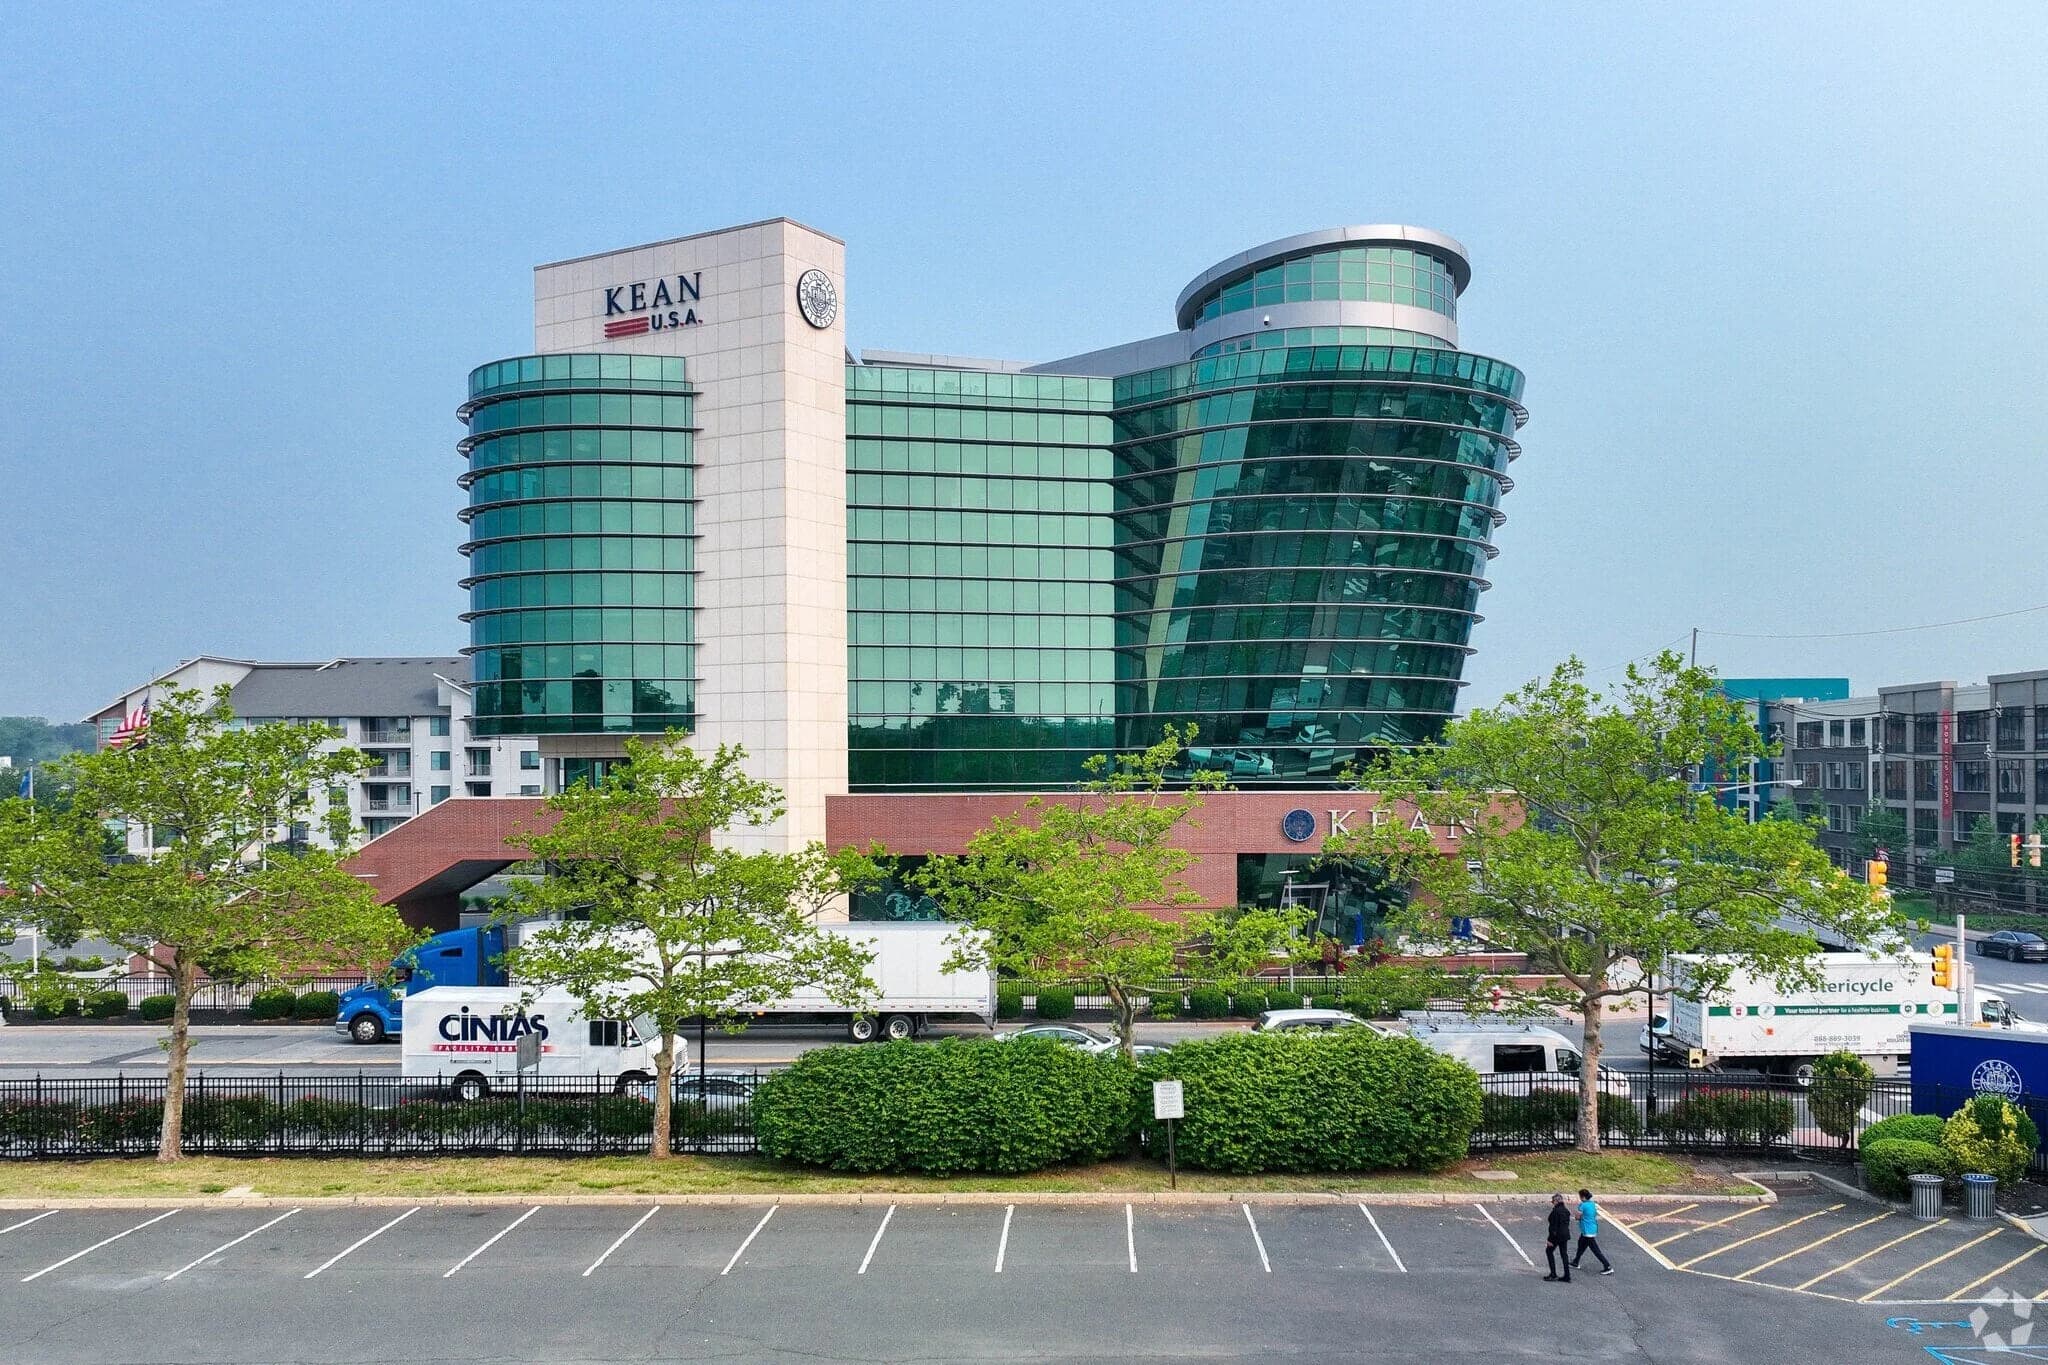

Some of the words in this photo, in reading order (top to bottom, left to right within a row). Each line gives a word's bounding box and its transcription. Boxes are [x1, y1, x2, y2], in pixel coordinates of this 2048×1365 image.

[604, 271, 702, 316] KEAN
[651, 308, 703, 330] U.S.A.
[1819, 1007, 1840, 1015] partner
[438, 1045, 488, 1053] FACILITY
